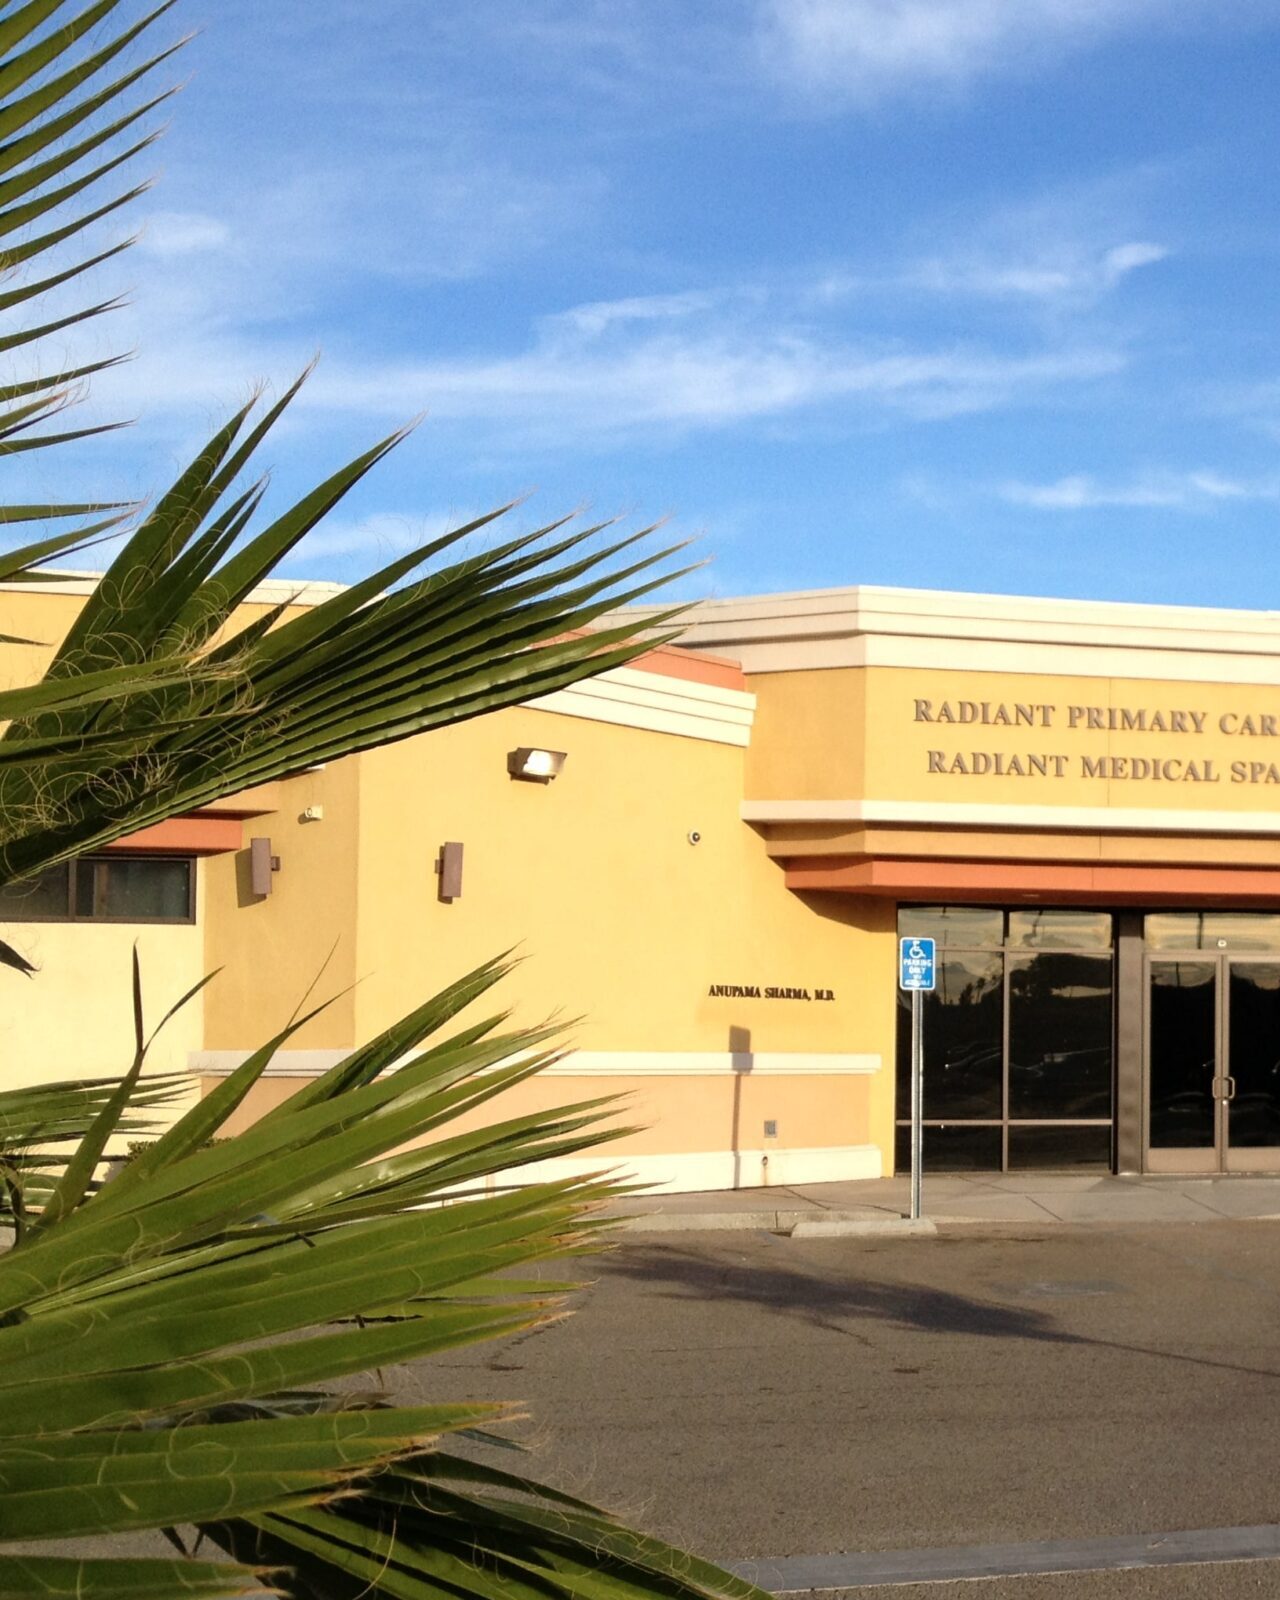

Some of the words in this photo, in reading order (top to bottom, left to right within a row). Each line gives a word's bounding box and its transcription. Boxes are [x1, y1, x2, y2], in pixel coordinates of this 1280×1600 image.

[914, 698, 1055, 727] RADIANT
[1067, 705, 1207, 733] PRIMARY
[927, 750, 1069, 778] RADIANT
[1080, 755, 1220, 783] MEDICAL
[904, 958, 932, 967] PARKING
[708, 984, 761, 999] ANUPAMA
[764, 986, 812, 1002] SHARMA,
